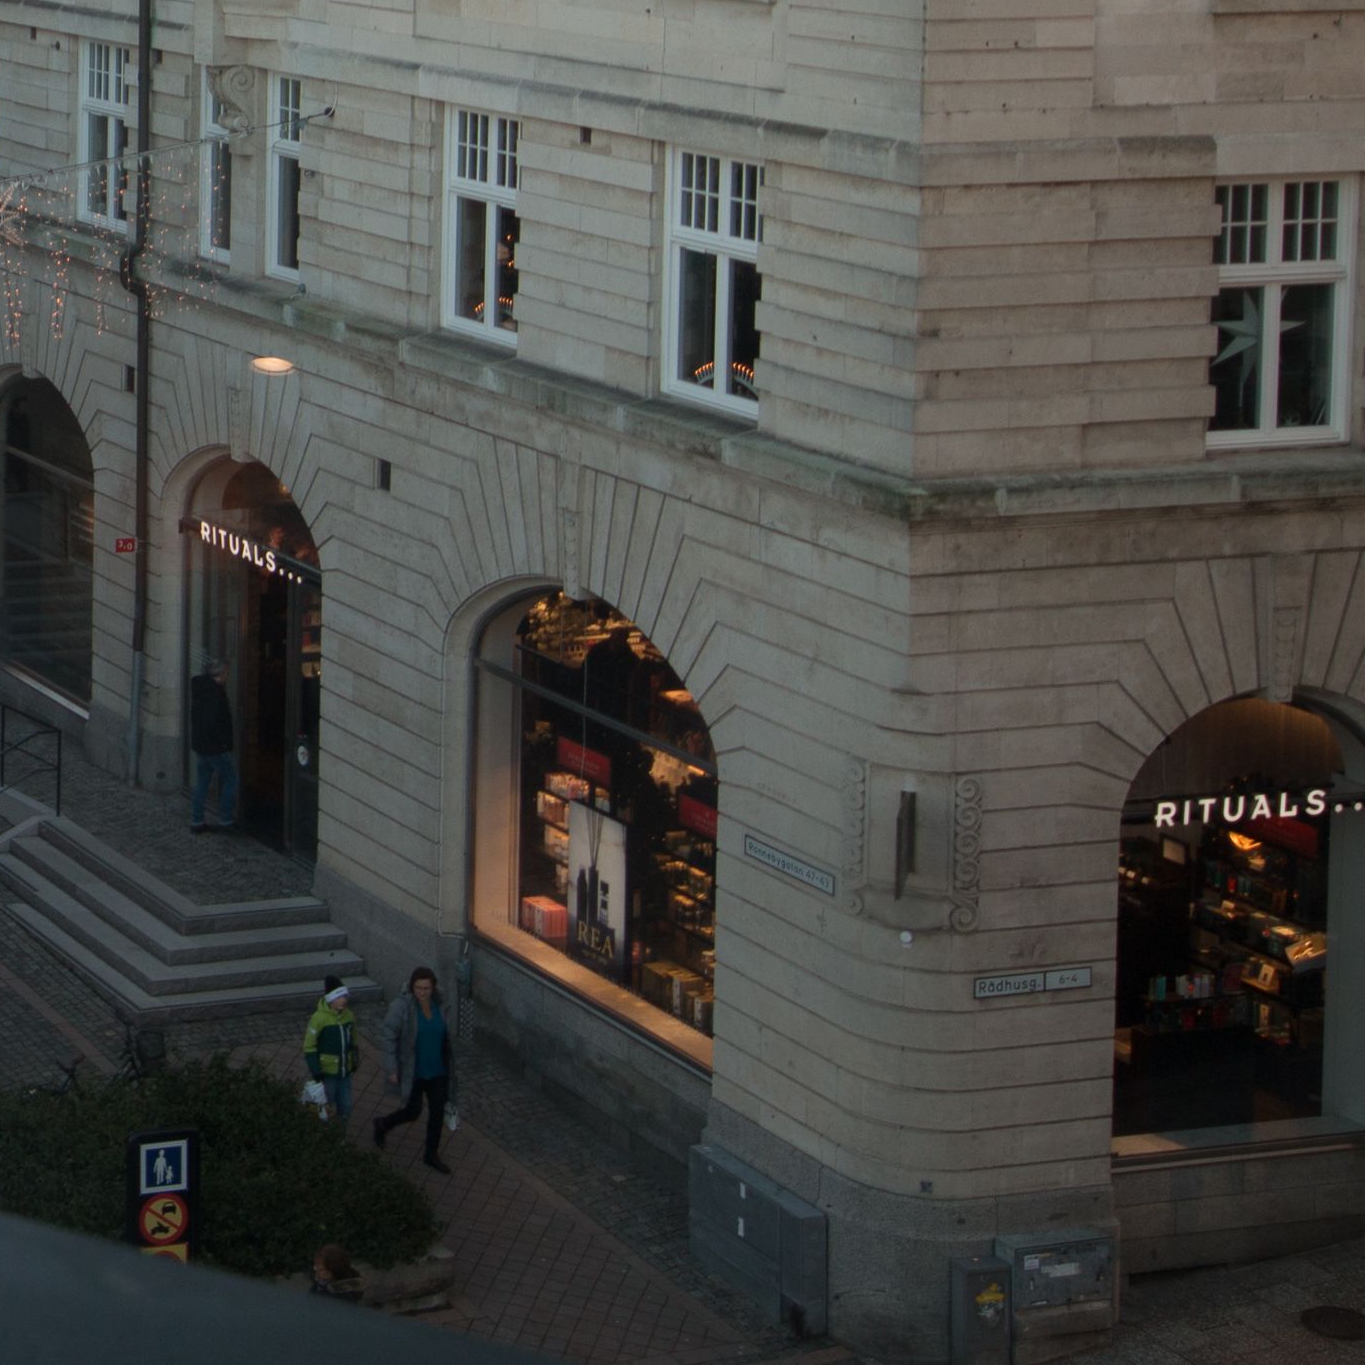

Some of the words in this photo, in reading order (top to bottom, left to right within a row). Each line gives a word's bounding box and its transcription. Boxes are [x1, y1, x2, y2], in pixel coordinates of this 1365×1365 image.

[577, 920, 614, 959] REA
[979, 978, 1042, 994] Rådhusg.
[1059, 973, 1078, 984] 6-4
